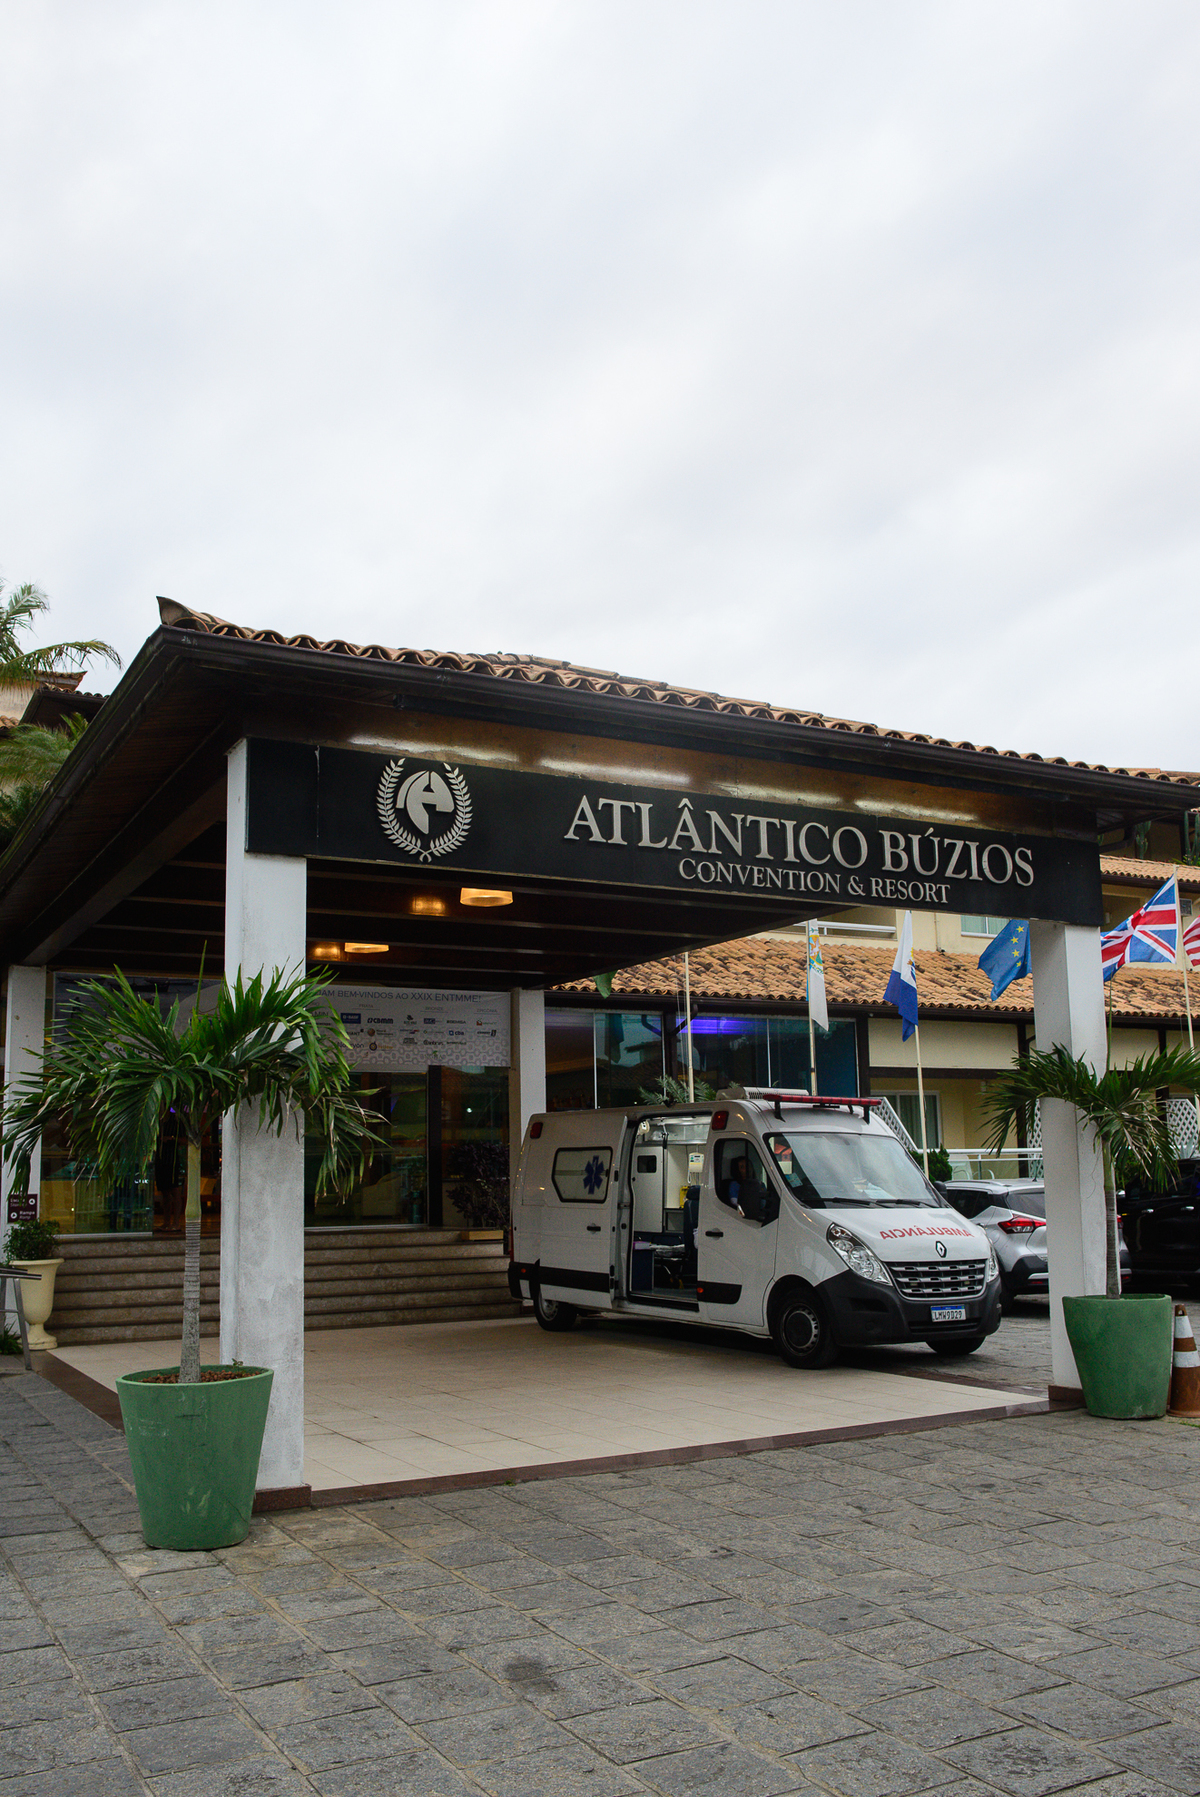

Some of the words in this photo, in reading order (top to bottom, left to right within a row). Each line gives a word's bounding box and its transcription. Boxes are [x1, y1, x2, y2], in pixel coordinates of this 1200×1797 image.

[563, 794, 868, 869] ATLÂNTICO
[878, 826, 1035, 887] BÚZIOS
[678, 857, 841, 894] CONVENTION
[847, 874, 866, 896] &
[871, 876, 950, 904] RESORT
[337, 990, 394, 999] BEM-VINDOS
[395, 992, 408, 1000] AO
[410, 992, 433, 1001] XXIX
[435, 993, 481, 1002] ENTMME!
[934, 1310, 962, 1320] LMW9D29
